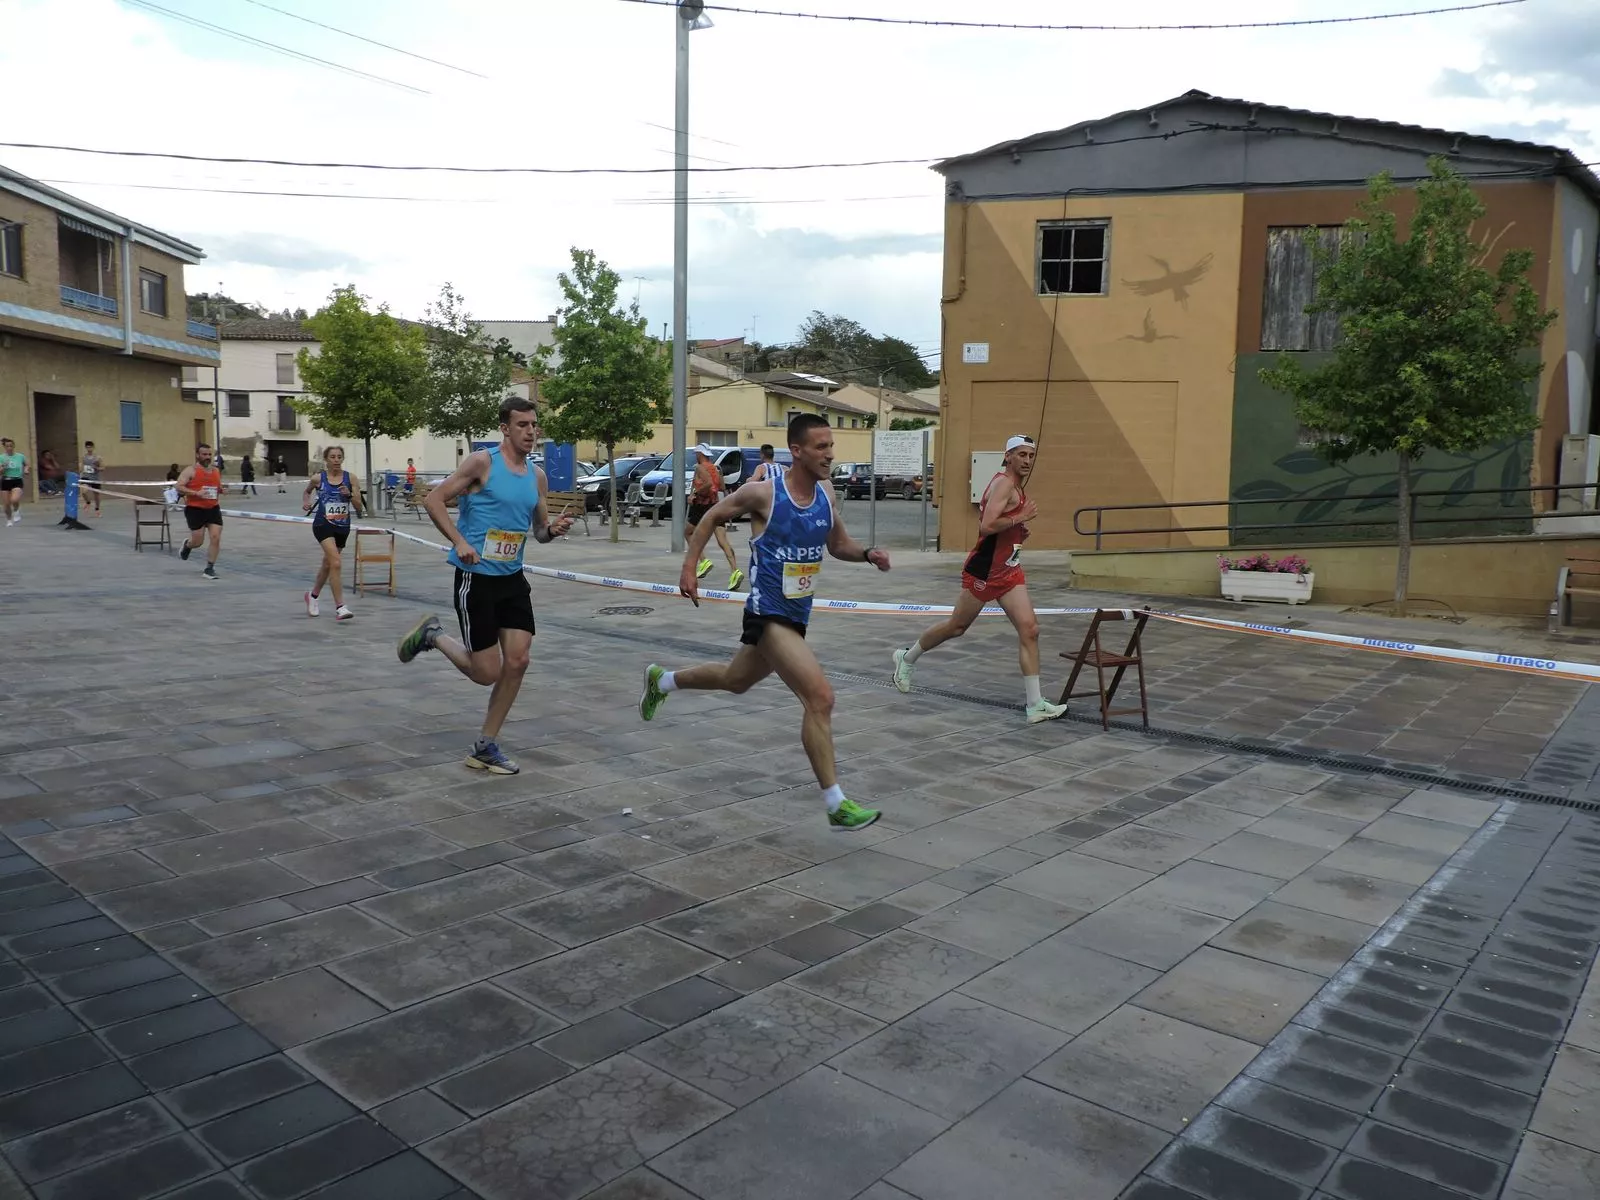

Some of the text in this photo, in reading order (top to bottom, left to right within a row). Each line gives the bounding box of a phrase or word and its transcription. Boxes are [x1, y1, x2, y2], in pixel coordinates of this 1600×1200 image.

[328, 506, 347, 514] 442
[495, 541, 518, 555] 103
[602, 578, 624, 587] hinaco
[798, 575, 812, 590] 95
[652, 585, 674, 593] hinaco
[706, 591, 730, 599] hinaco
[828, 600, 858, 608] hinaco
[1496, 654, 1556, 669] hinaco
